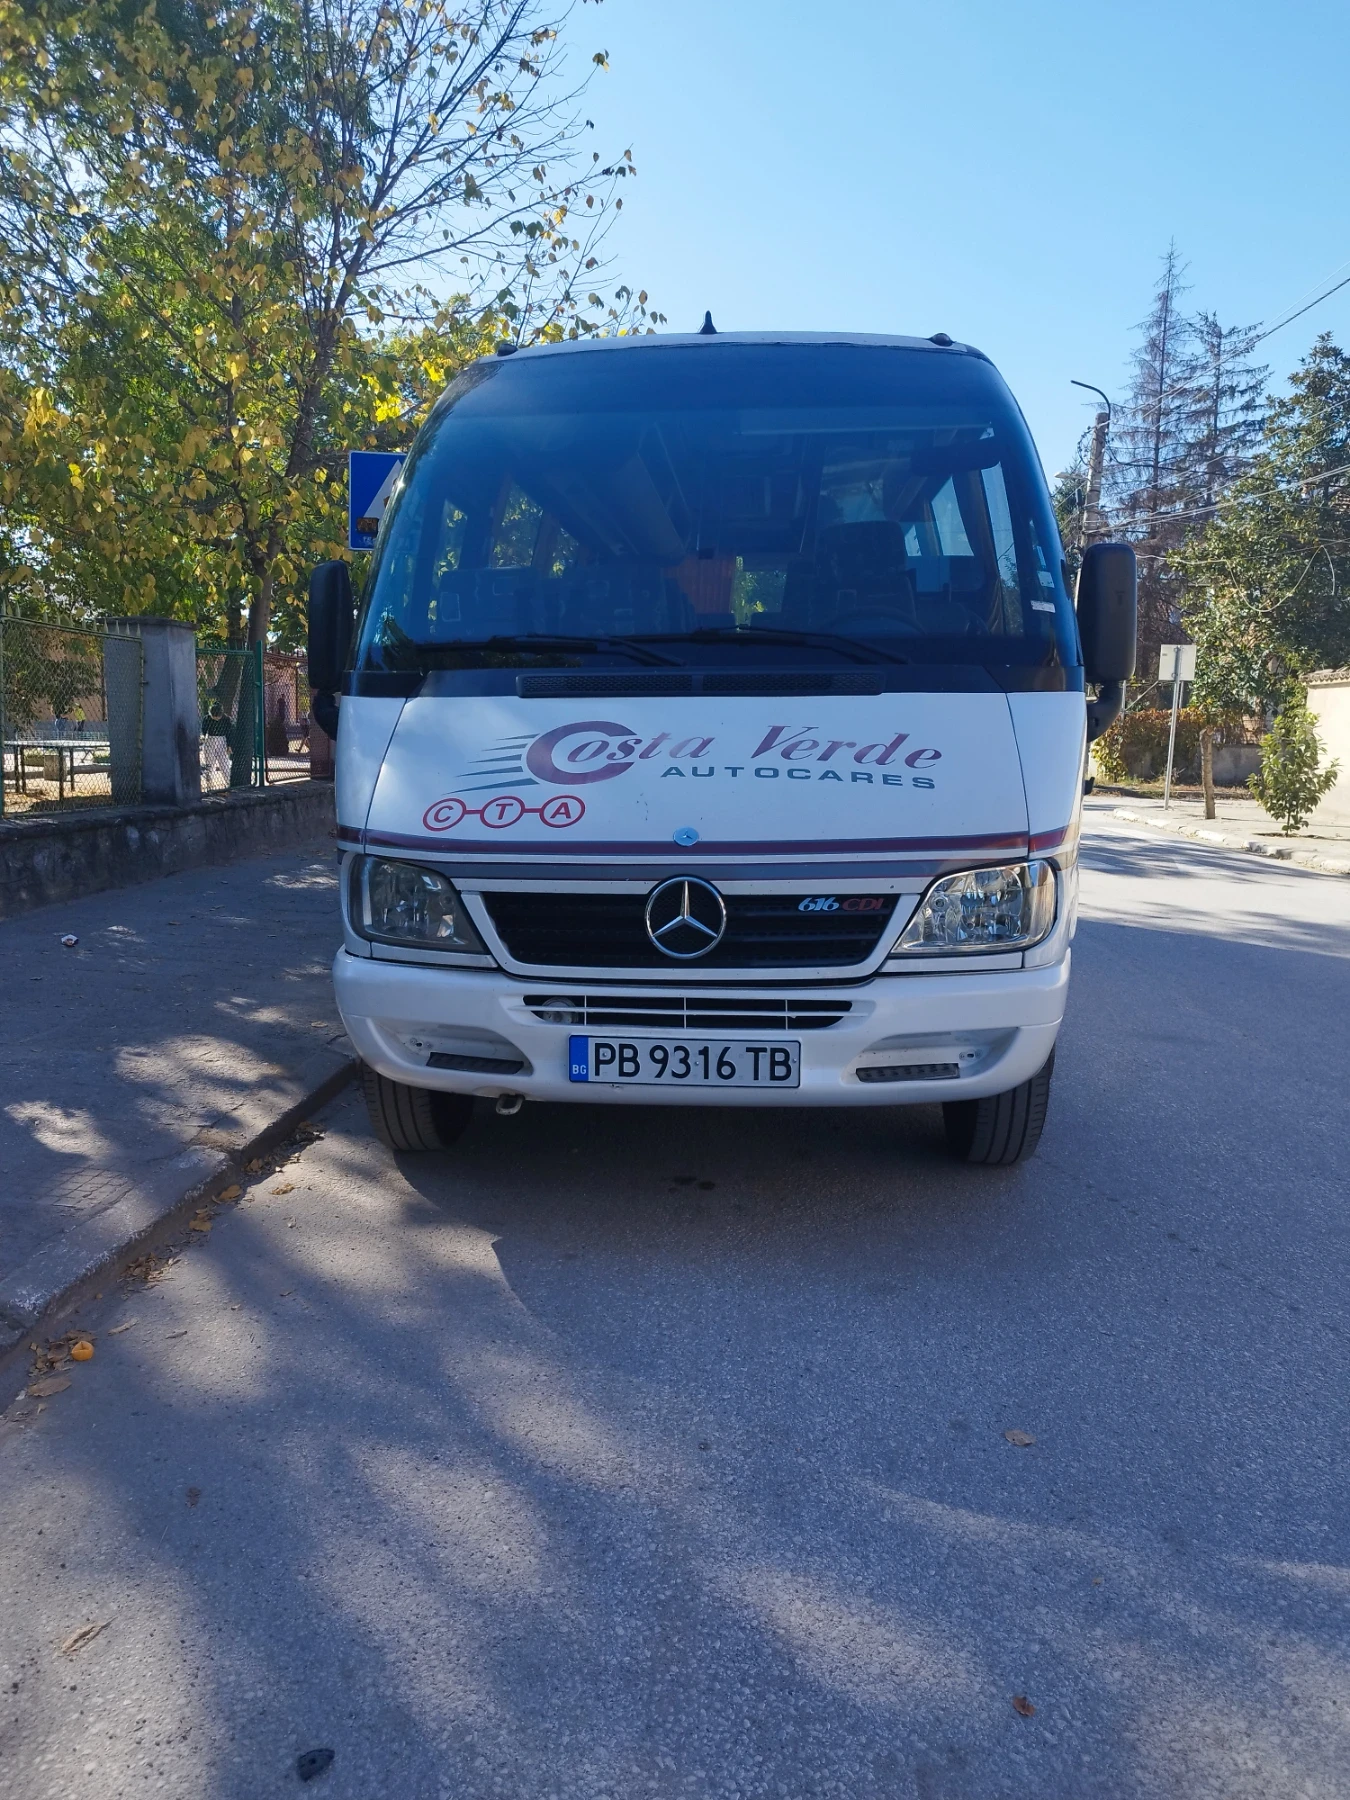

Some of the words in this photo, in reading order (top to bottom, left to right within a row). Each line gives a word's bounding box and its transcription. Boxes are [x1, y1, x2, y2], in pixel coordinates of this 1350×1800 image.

[526, 720, 716, 785] Costa
[750, 725, 943, 769] Verde
[660, 766, 936, 790] AUTOCARES
[798, 897, 840, 911] 616
[842, 898, 885, 911] CDI
[572, 1064, 587, 1075] BG
[594, 1042, 641, 1078] PB
[649, 1044, 737, 1080] 9316
[745, 1046, 793, 1082] TB
